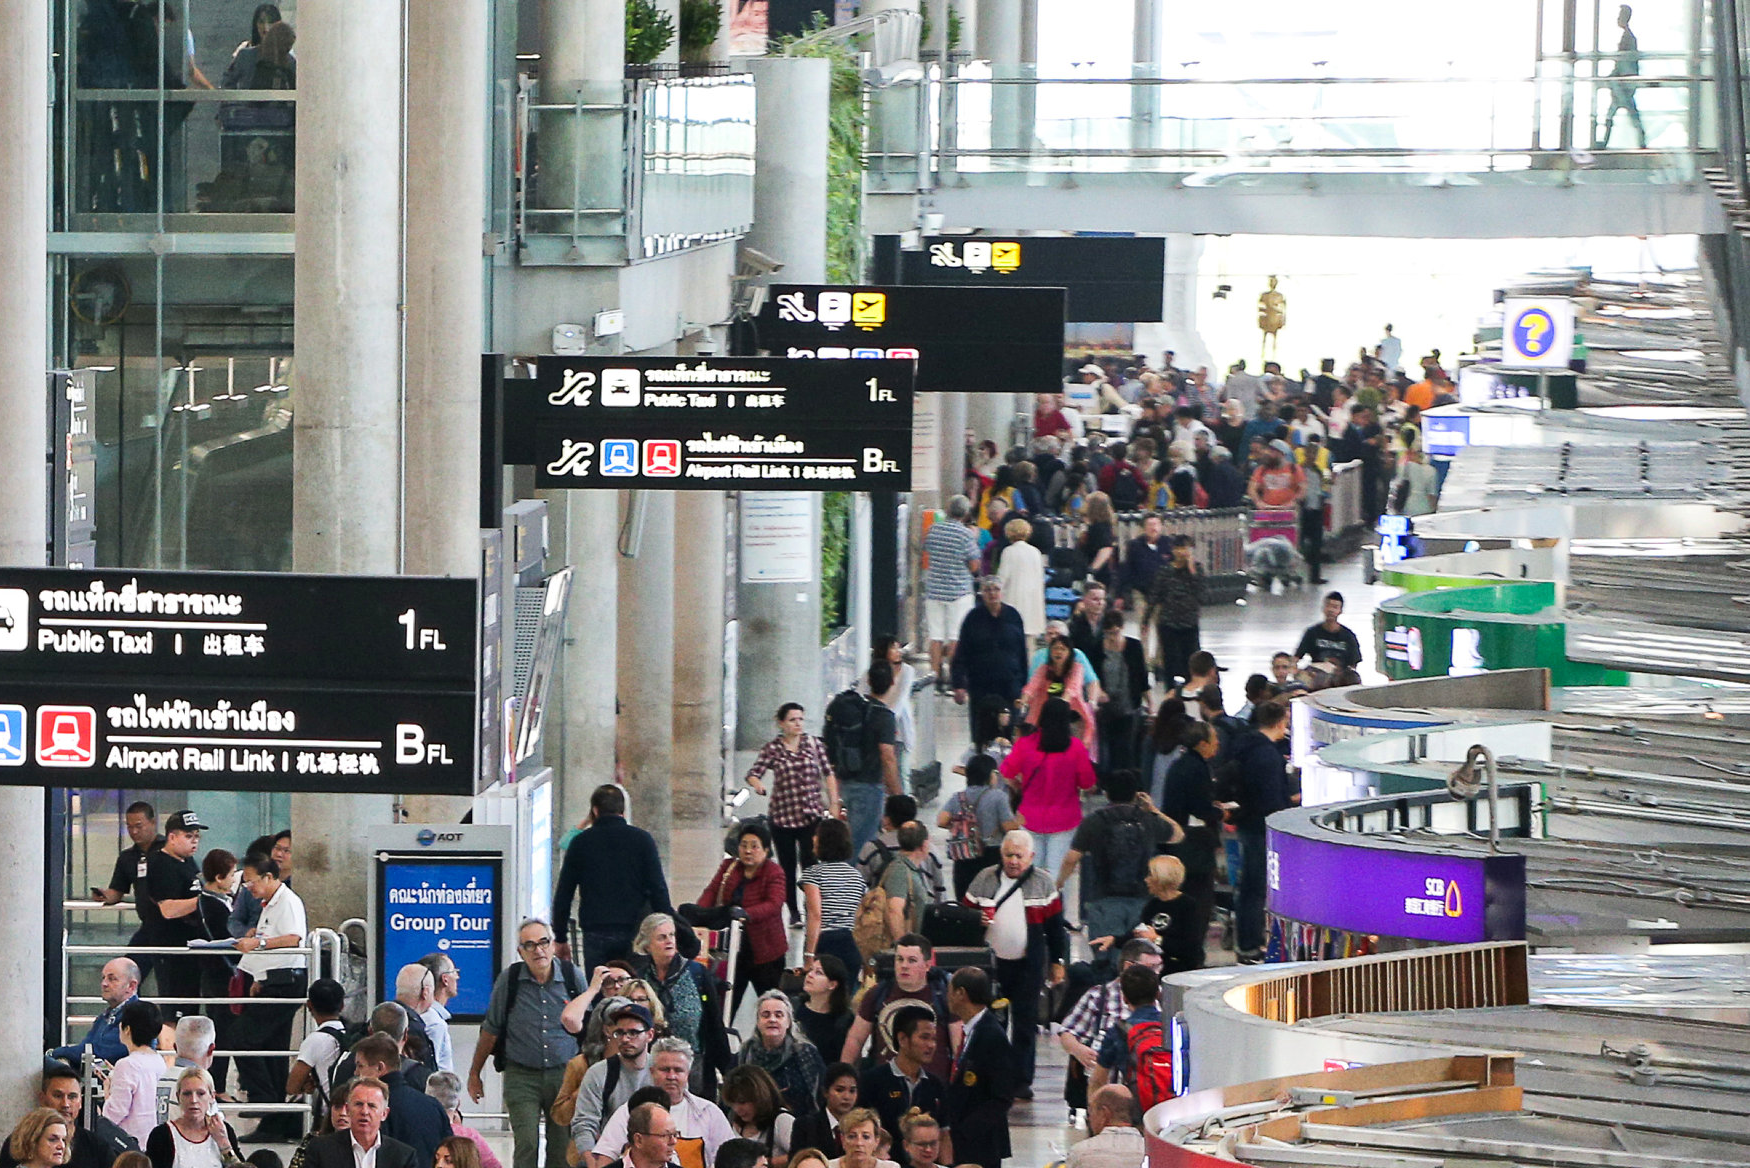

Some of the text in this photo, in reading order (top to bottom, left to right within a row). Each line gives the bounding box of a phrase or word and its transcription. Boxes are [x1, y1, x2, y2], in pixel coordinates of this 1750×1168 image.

[38, 629, 154, 655] Public Taxi
[203, 633, 266, 657] 出租车
[106, 746, 275, 773] Airport Rail Link
[437, 833, 464, 841] AOT
[388, 876, 492, 904] คณะนักท่องเที่ยว
[390, 913, 491, 934] Group Tour
